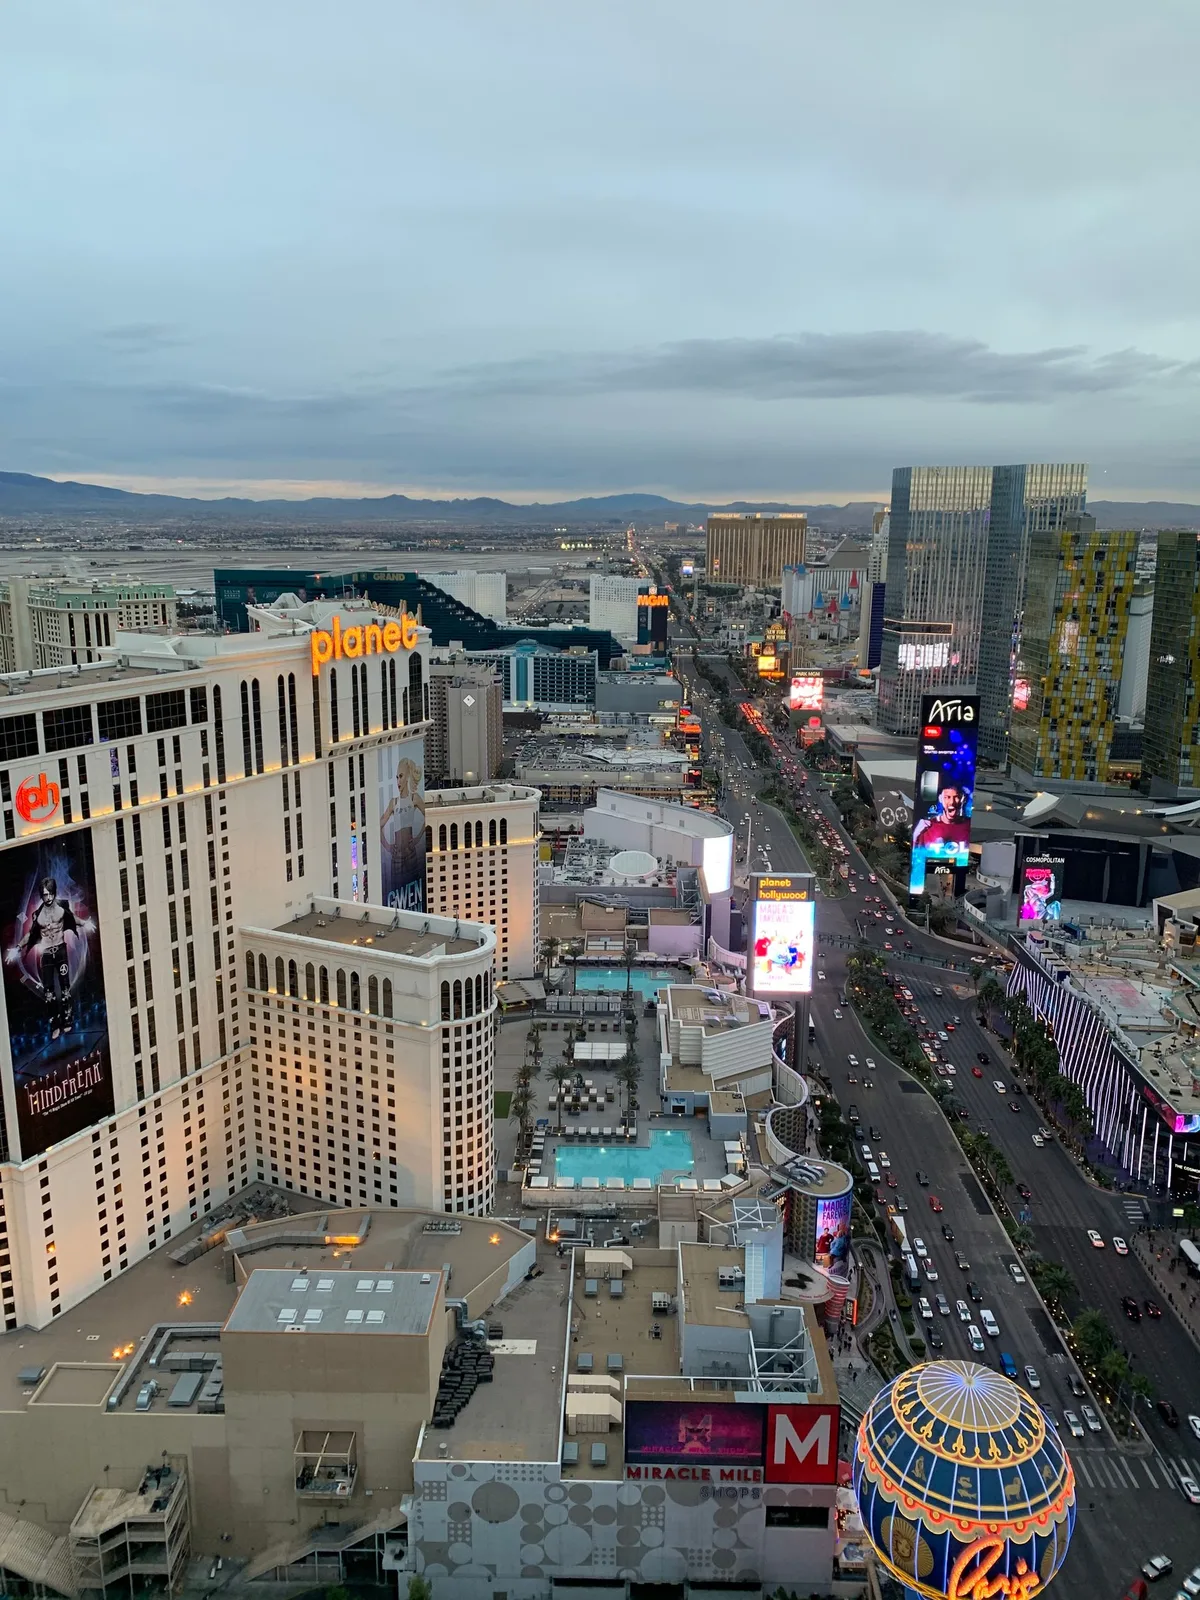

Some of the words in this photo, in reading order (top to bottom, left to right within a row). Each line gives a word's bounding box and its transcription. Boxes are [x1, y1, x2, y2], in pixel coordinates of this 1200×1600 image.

[373, 573, 405, 581] GRAND
[637, 595, 669, 606] MGM
[311, 614, 419, 676] planet
[928, 700, 974, 723] Aria
[21, 773, 60, 821] ph
[929, 841, 969, 854] TCL
[934, 866, 950, 874] Aria
[760, 878, 791, 888] planet
[388, 878, 422, 910] GWEN
[759, 890, 807, 901] hollywood
[29, 1062, 103, 1115] MINDFREAK
[774, 1414, 831, 1465] M
[627, 1466, 710, 1480] MIRACLE
[720, 1468, 761, 1482] MILE
[701, 1486, 760, 1499] SHOPS
